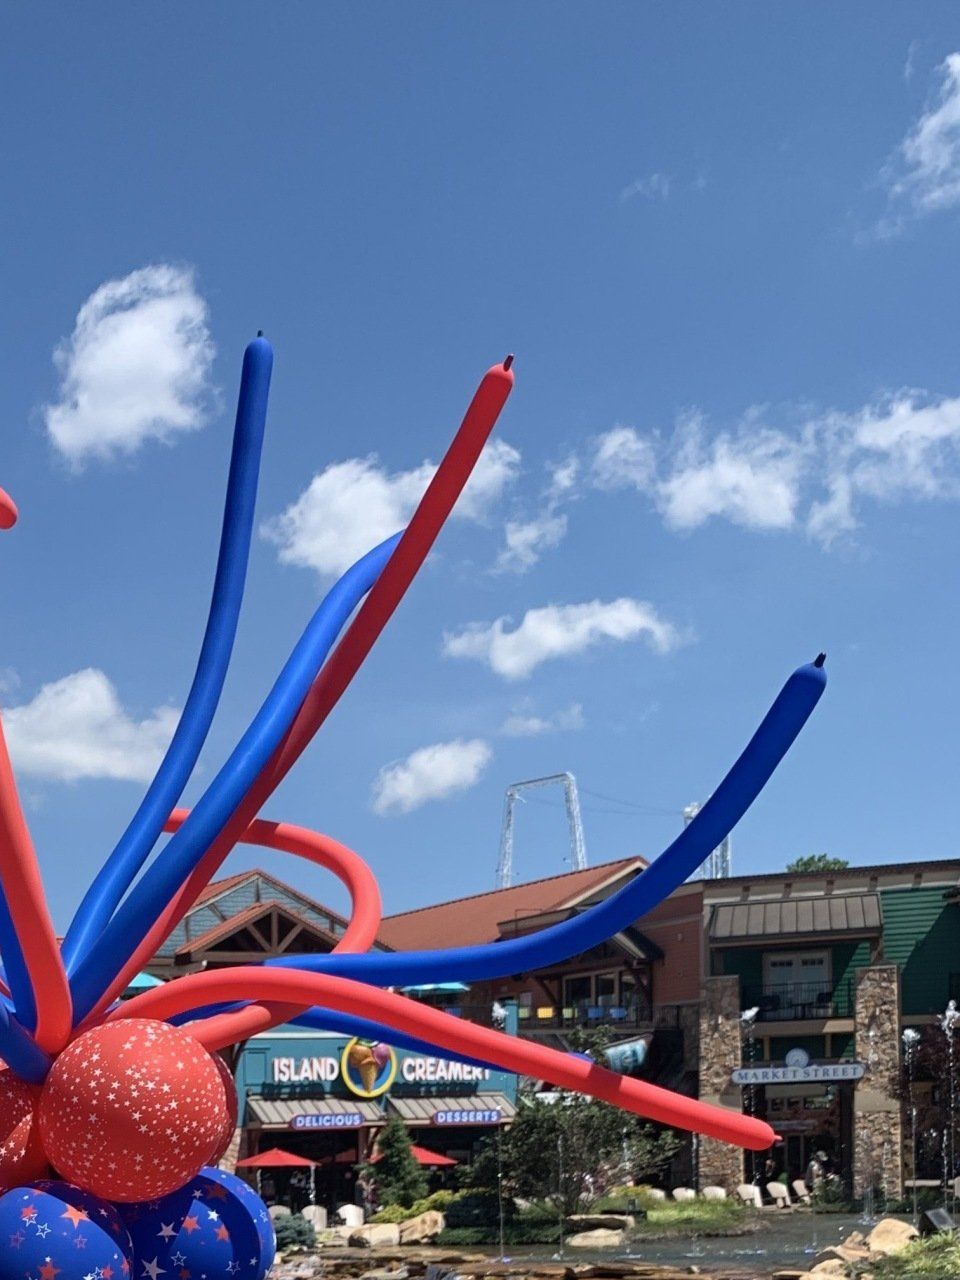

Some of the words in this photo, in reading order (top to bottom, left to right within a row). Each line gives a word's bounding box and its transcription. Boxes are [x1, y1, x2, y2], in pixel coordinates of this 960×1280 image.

[272, 1057, 340, 1082] ISLAND
[737, 1068, 798, 1081] MARKET
[802, 1066, 859, 1079] STREET
[295, 1114, 361, 1127] DELICIOUS
[436, 1110, 498, 1122] DESSERTS
